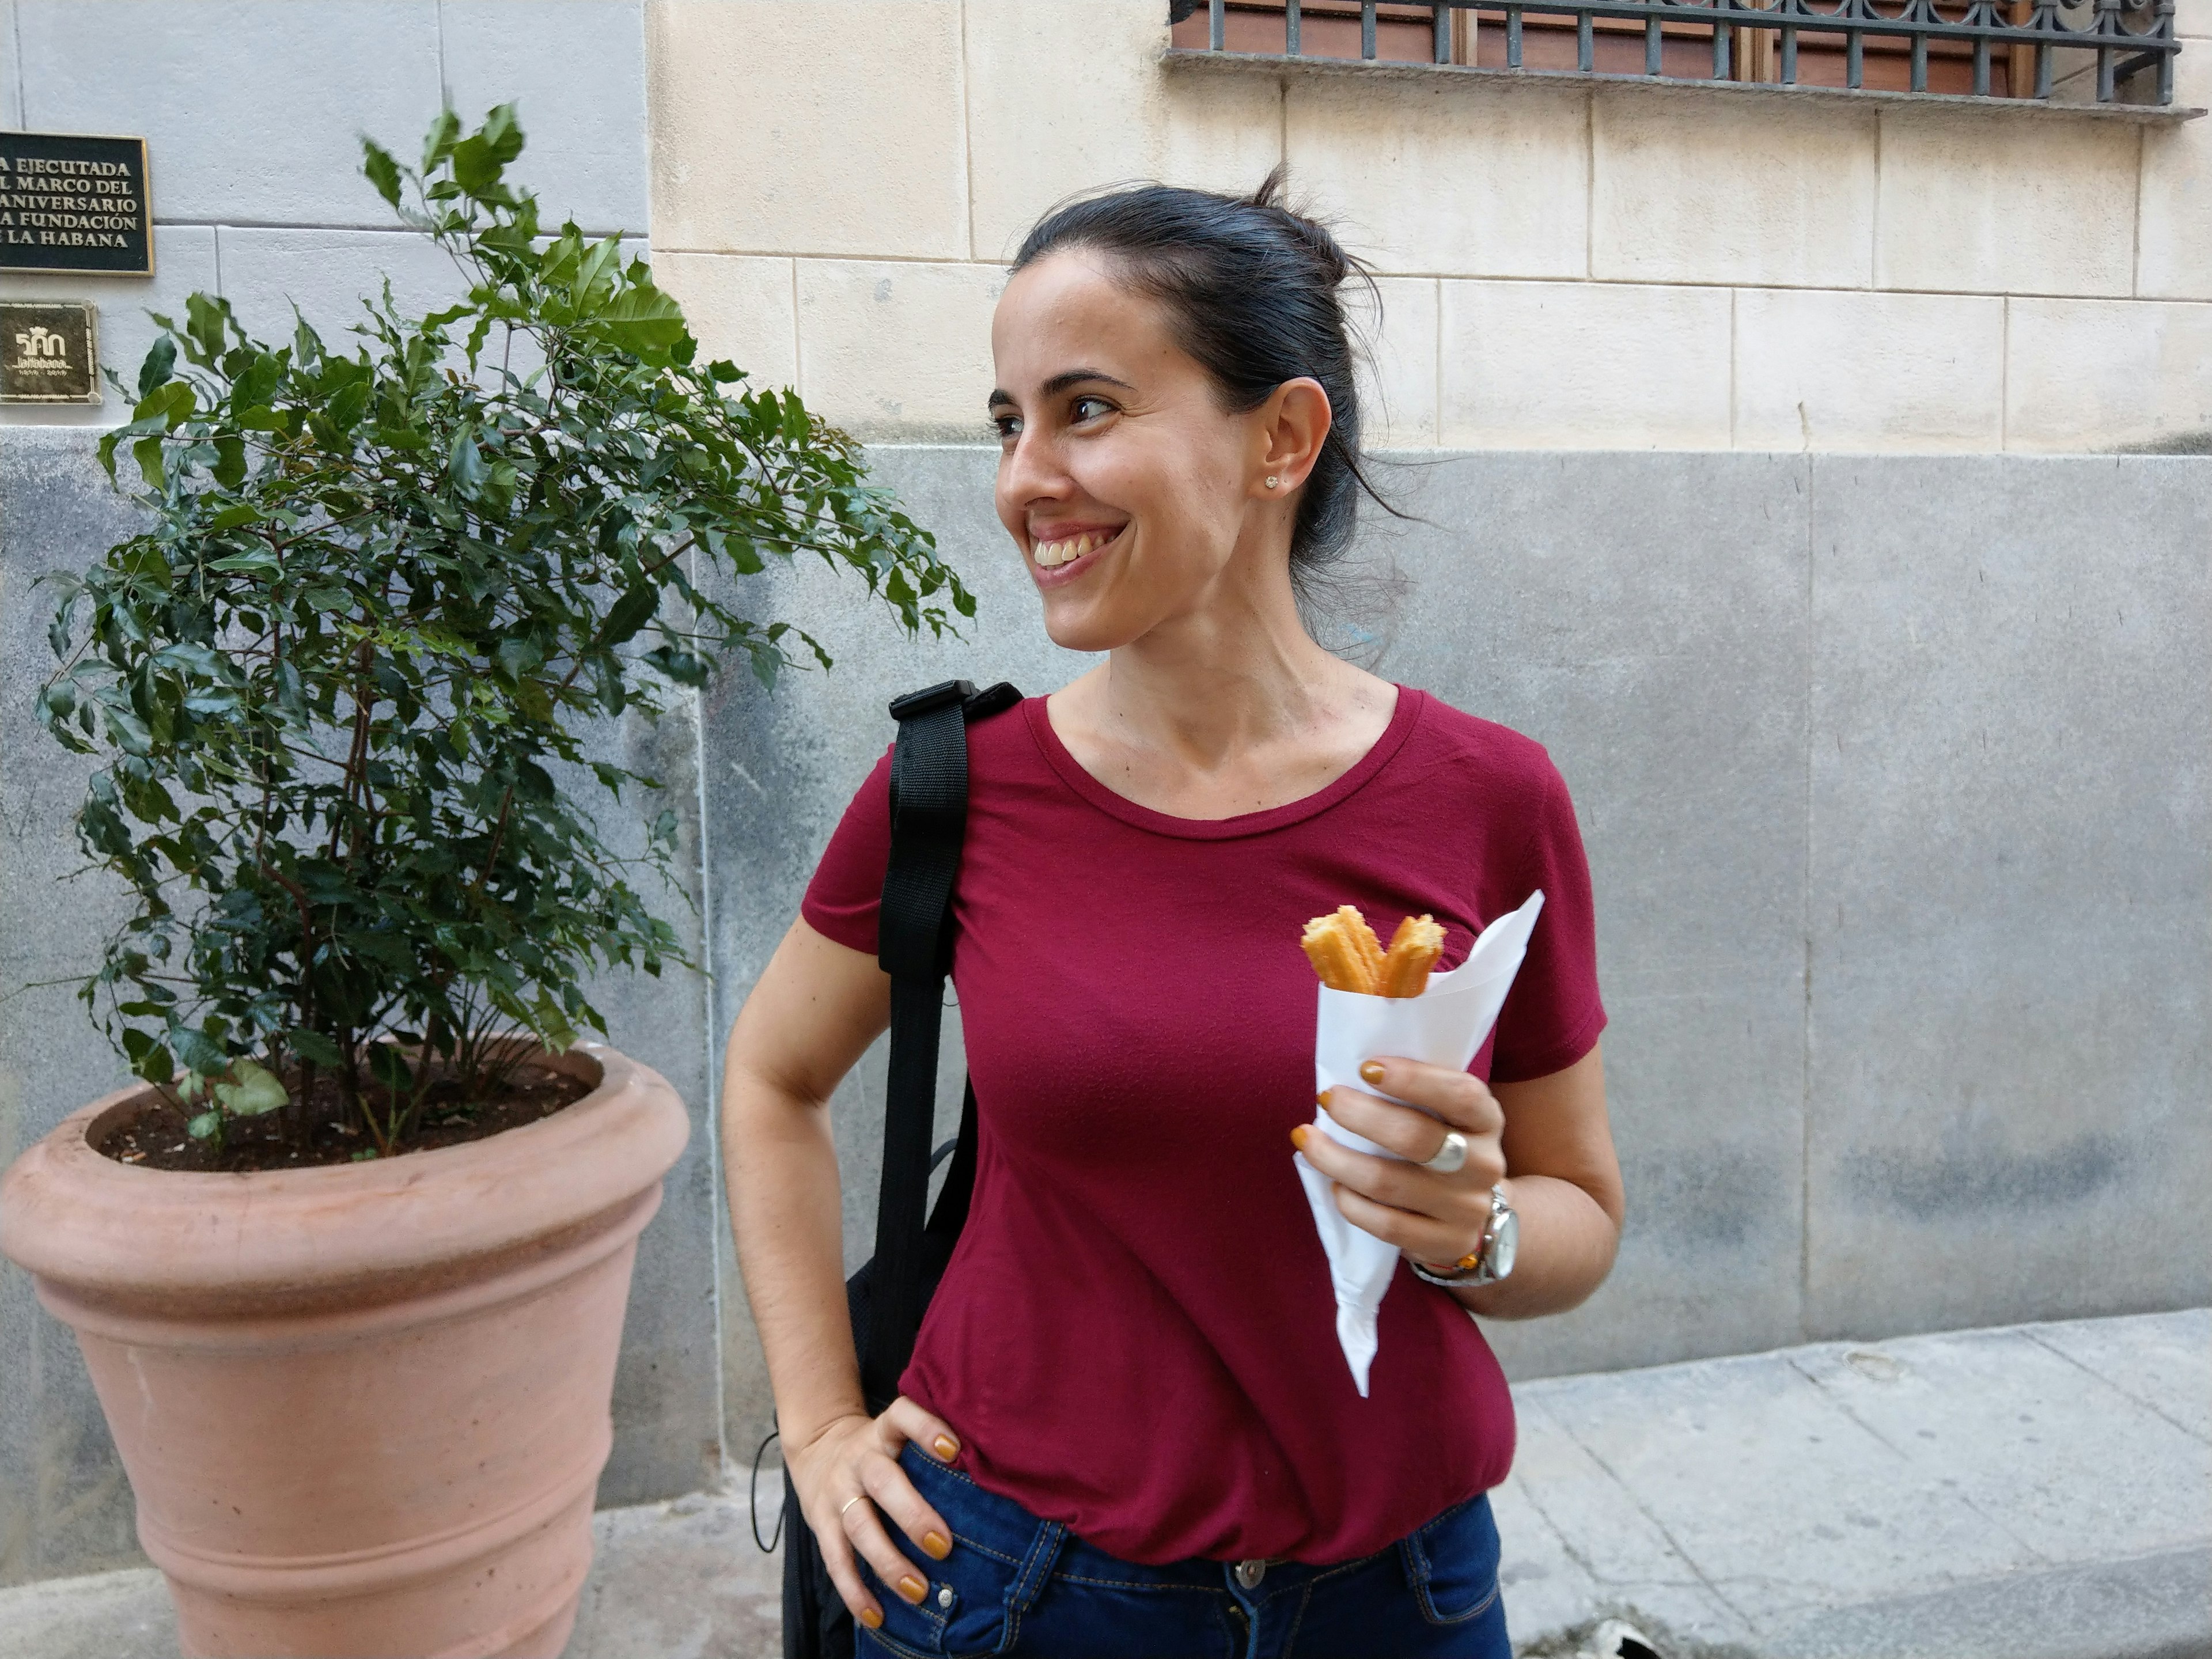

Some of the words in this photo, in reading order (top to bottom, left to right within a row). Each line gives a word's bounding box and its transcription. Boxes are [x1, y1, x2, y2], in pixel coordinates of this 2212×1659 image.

[16, 158, 131, 177] EJECUTADA
[16, 176, 90, 193] MARCO
[95, 180, 132, 195] DEL
[0, 194, 138, 213] ANIVERSARIO
[20, 212, 138, 230] FUNDACIÓN
[7, 230, 35, 244] LA
[39, 231, 128, 248] HABANA
